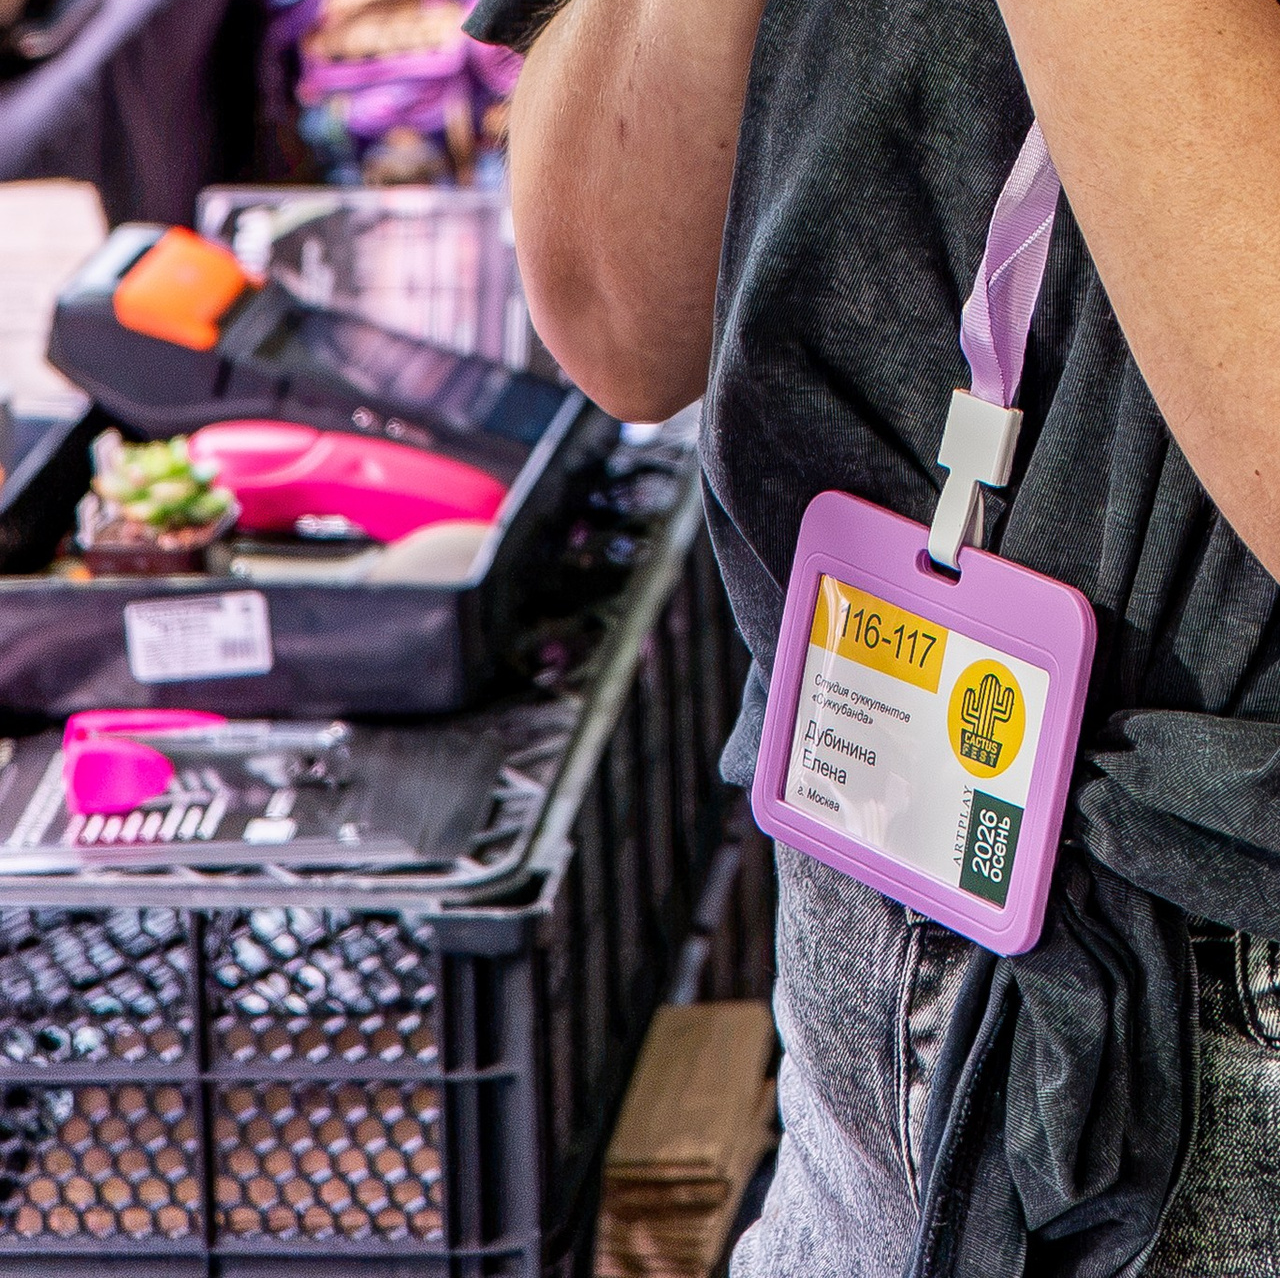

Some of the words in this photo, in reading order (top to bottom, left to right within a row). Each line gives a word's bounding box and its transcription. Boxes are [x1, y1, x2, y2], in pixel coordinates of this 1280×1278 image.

[841, 602, 937, 669] 116-117
[811, 693, 874, 725] «Суккубанда»
[814, 673, 849, 698] Студия
[850, 691, 911, 724] суккулентов
[802, 748, 848, 785] Елена
[804, 719, 877, 767] Дубинина
[962, 744, 998, 766] FEST
[964, 732, 999, 754] CACTUS
[806, 787, 841, 812] Москва
[953, 785, 973, 868] ARTPLAY
[971, 808, 998, 878] 2026
[990, 816, 1011, 883] осень
